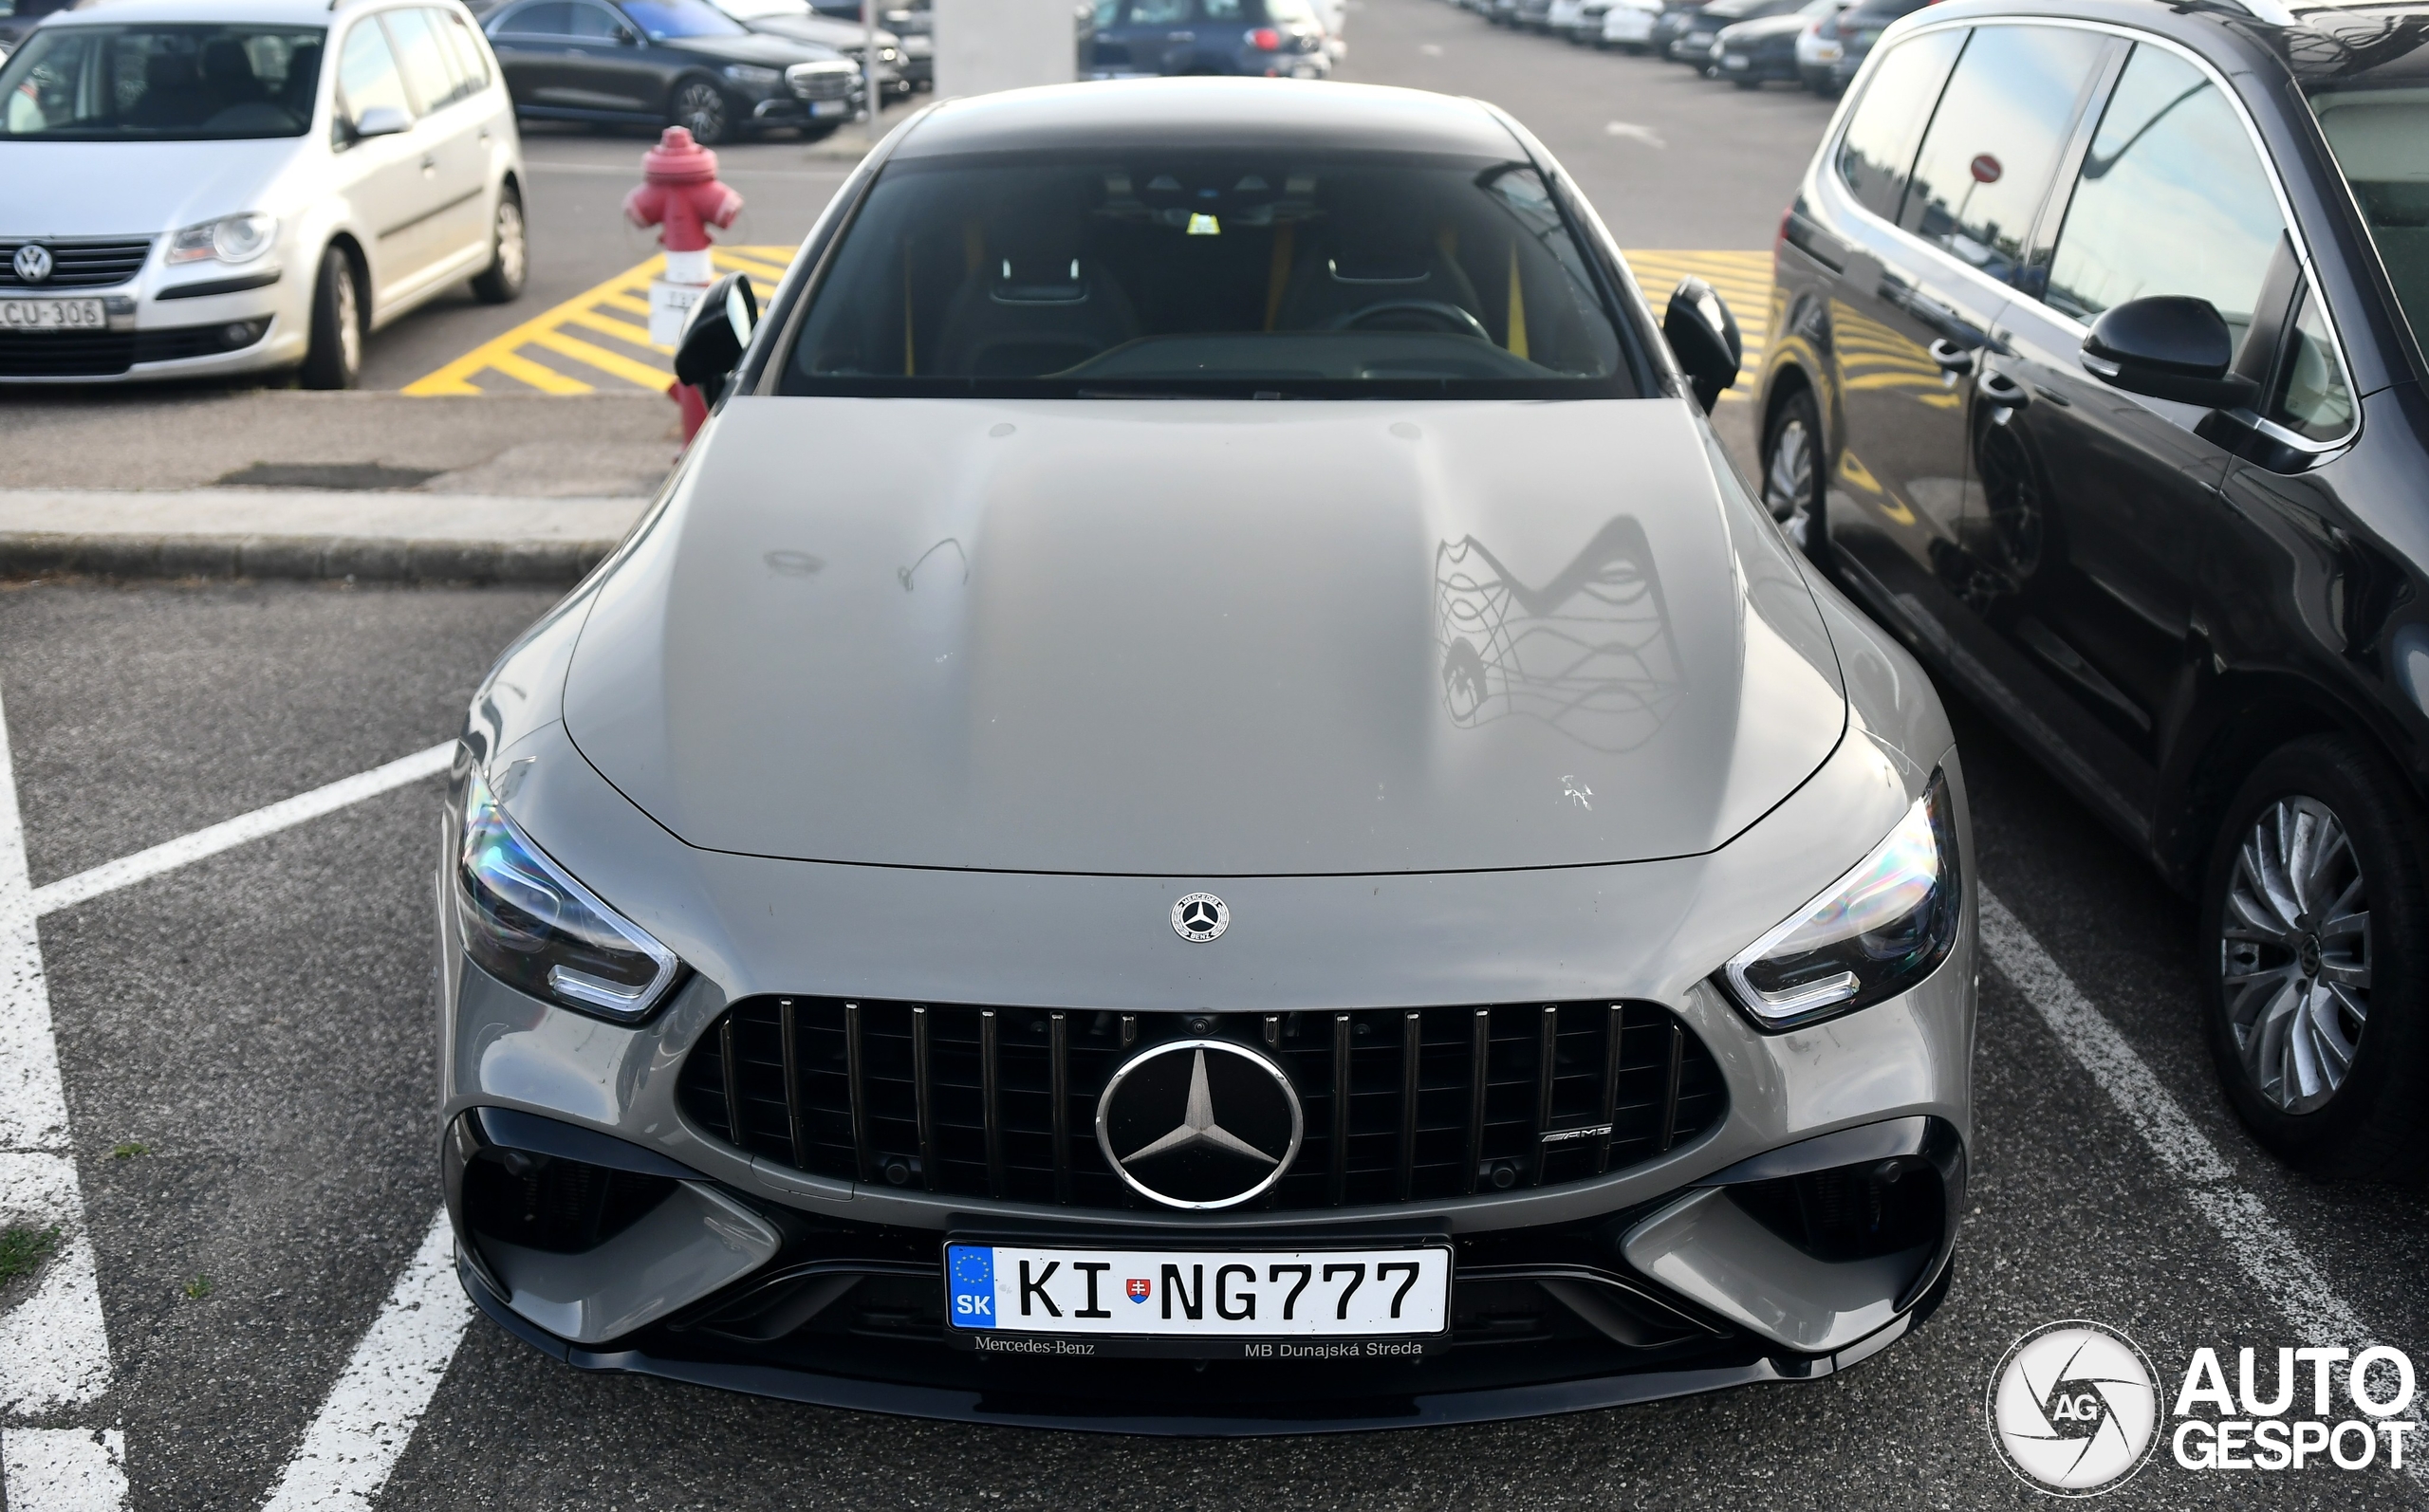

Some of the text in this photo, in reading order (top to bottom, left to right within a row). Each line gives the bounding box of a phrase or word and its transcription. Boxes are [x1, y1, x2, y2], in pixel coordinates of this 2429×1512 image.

[0, 302, 97, 325] CU-306
[1181, 894, 1219, 905] MERCEDES
[1562, 1127, 1612, 1140] AMG
[1018, 1260, 1420, 1320] KI NG777
[956, 1294, 992, 1316] SK
[974, 1336, 1095, 1355] Mercedes-Benz
[1245, 1341, 1422, 1359] MB Dunajská Streda
